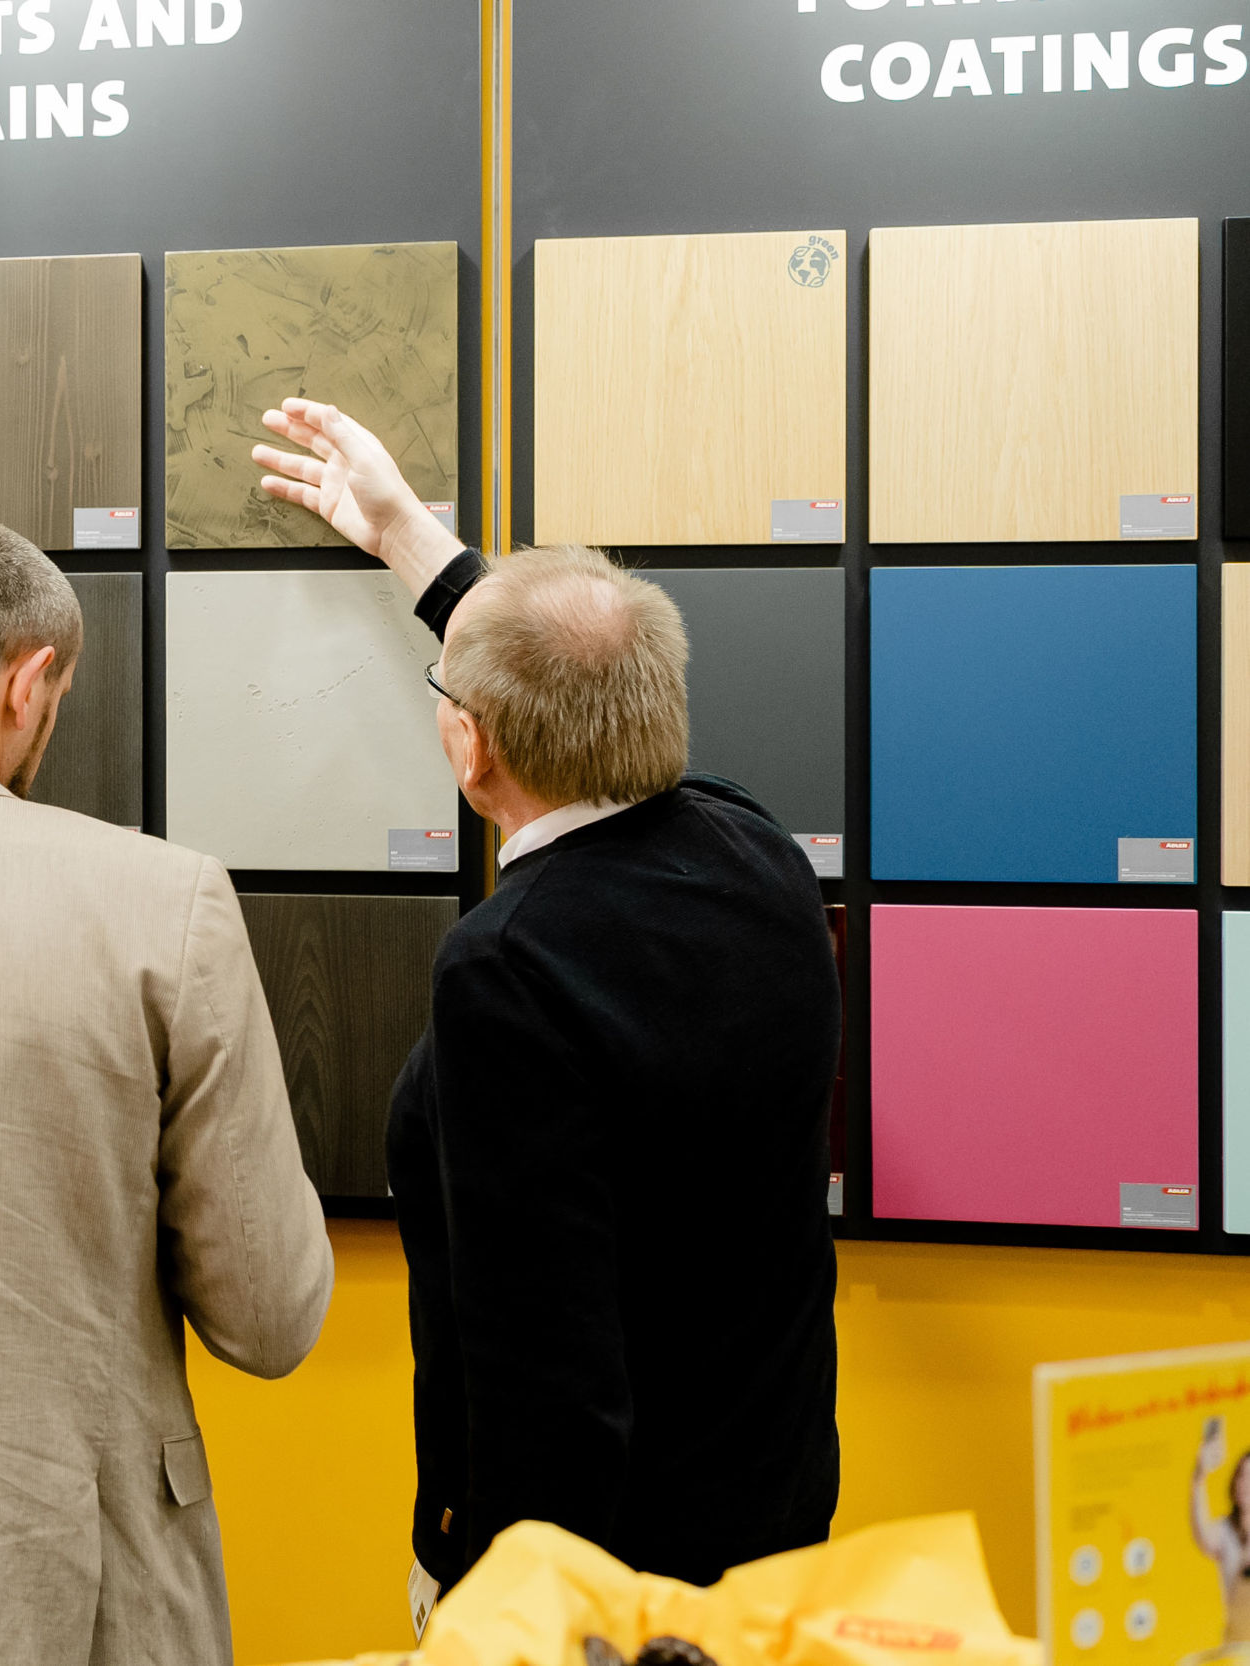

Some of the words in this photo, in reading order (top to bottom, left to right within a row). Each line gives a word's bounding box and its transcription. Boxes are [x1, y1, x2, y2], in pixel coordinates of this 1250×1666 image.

[79, 0, 244, 51] AND
[820, 24, 1248, 102] COATINGS
[808, 235, 839, 260] green
